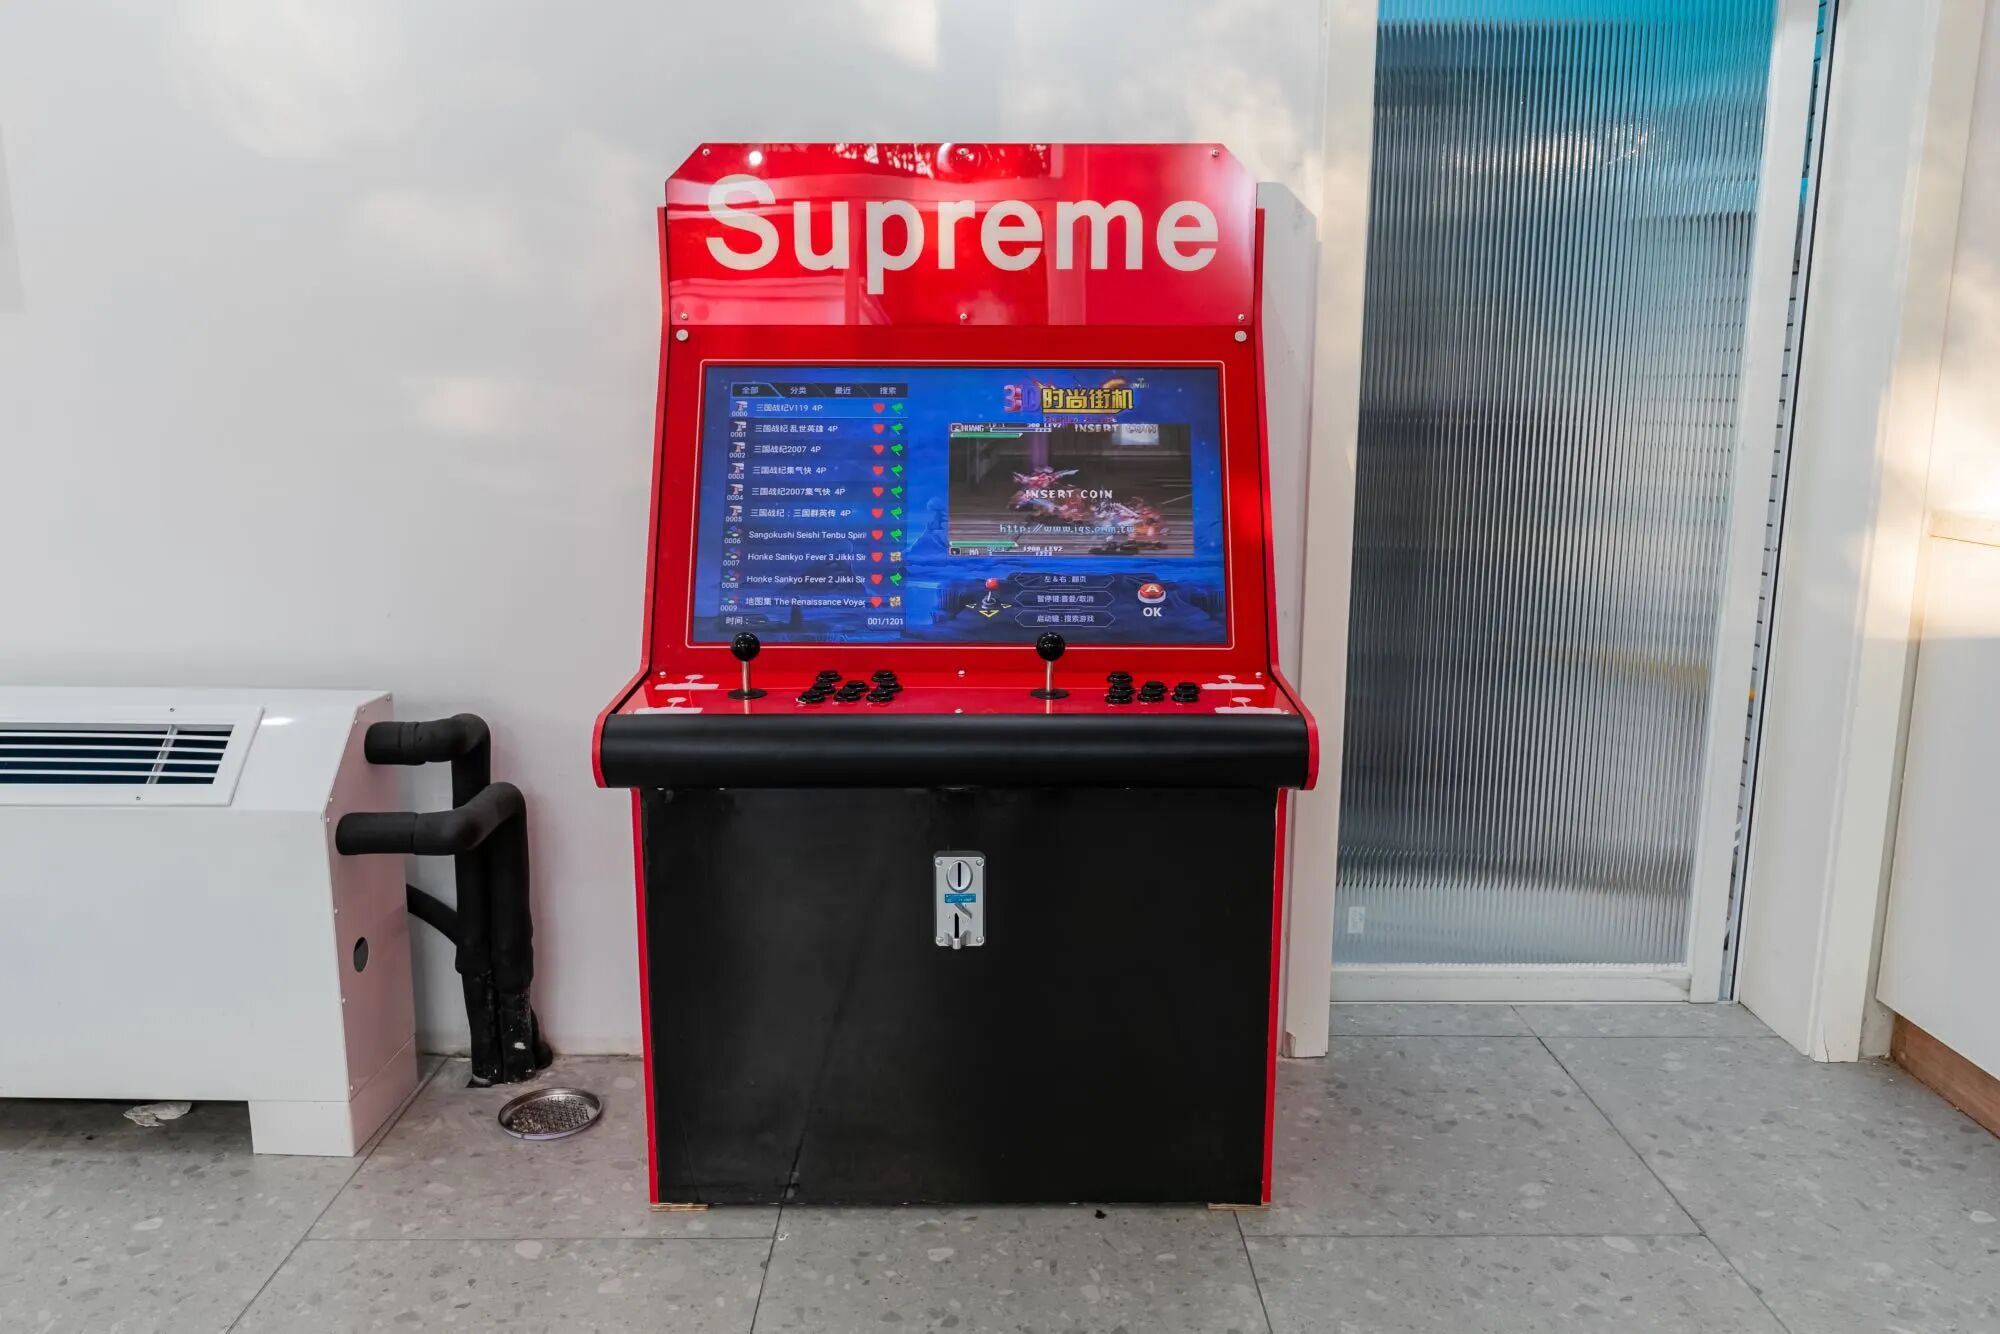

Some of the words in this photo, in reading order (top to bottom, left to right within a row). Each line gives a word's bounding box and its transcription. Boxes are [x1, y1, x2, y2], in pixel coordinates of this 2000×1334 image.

[705, 173, 1219, 295] Supreme
[741, 386, 759, 395] 全部
[790, 386, 807, 395] 分类
[834, 386, 851, 395] 最近
[880, 386, 897, 395] 搜索
[812, 404, 823, 412] 4P
[754, 424, 788, 433] 三国战纪
[827, 425, 838, 433] 4P
[1075, 423, 1120, 433] INSERT
[753, 445, 807, 453] 三国战纪2007
[810, 445, 821, 453] 4P
[815, 467, 827, 475] 4P
[834, 488, 846, 496] 4P
[1025, 490, 1074, 499] INSERT
[1080, 490, 1114, 499] COIN
[840, 509, 851, 517] 4P
[749, 531, 795, 540] Sangokushi
[797, 531, 818, 539] Seishi
[822, 531, 846, 539] Tenbu
[748, 553, 773, 561] Honke
[775, 553, 804, 563] Sankyo
[806, 553, 827, 561] Fever
[836, 553, 854, 561] Jikki
[746, 575, 773, 583] Honke
[774, 575, 803, 584] Sankyo
[805, 575, 826, 583] Fever
[835, 575, 854, 583] Jikki
[1144, 583, 1160, 593] A
[774, 598, 790, 606] The
[791, 598, 842, 606] Renaissance
[1142, 606, 1162, 617] OK
[867, 617, 904, 626] 001/1201
